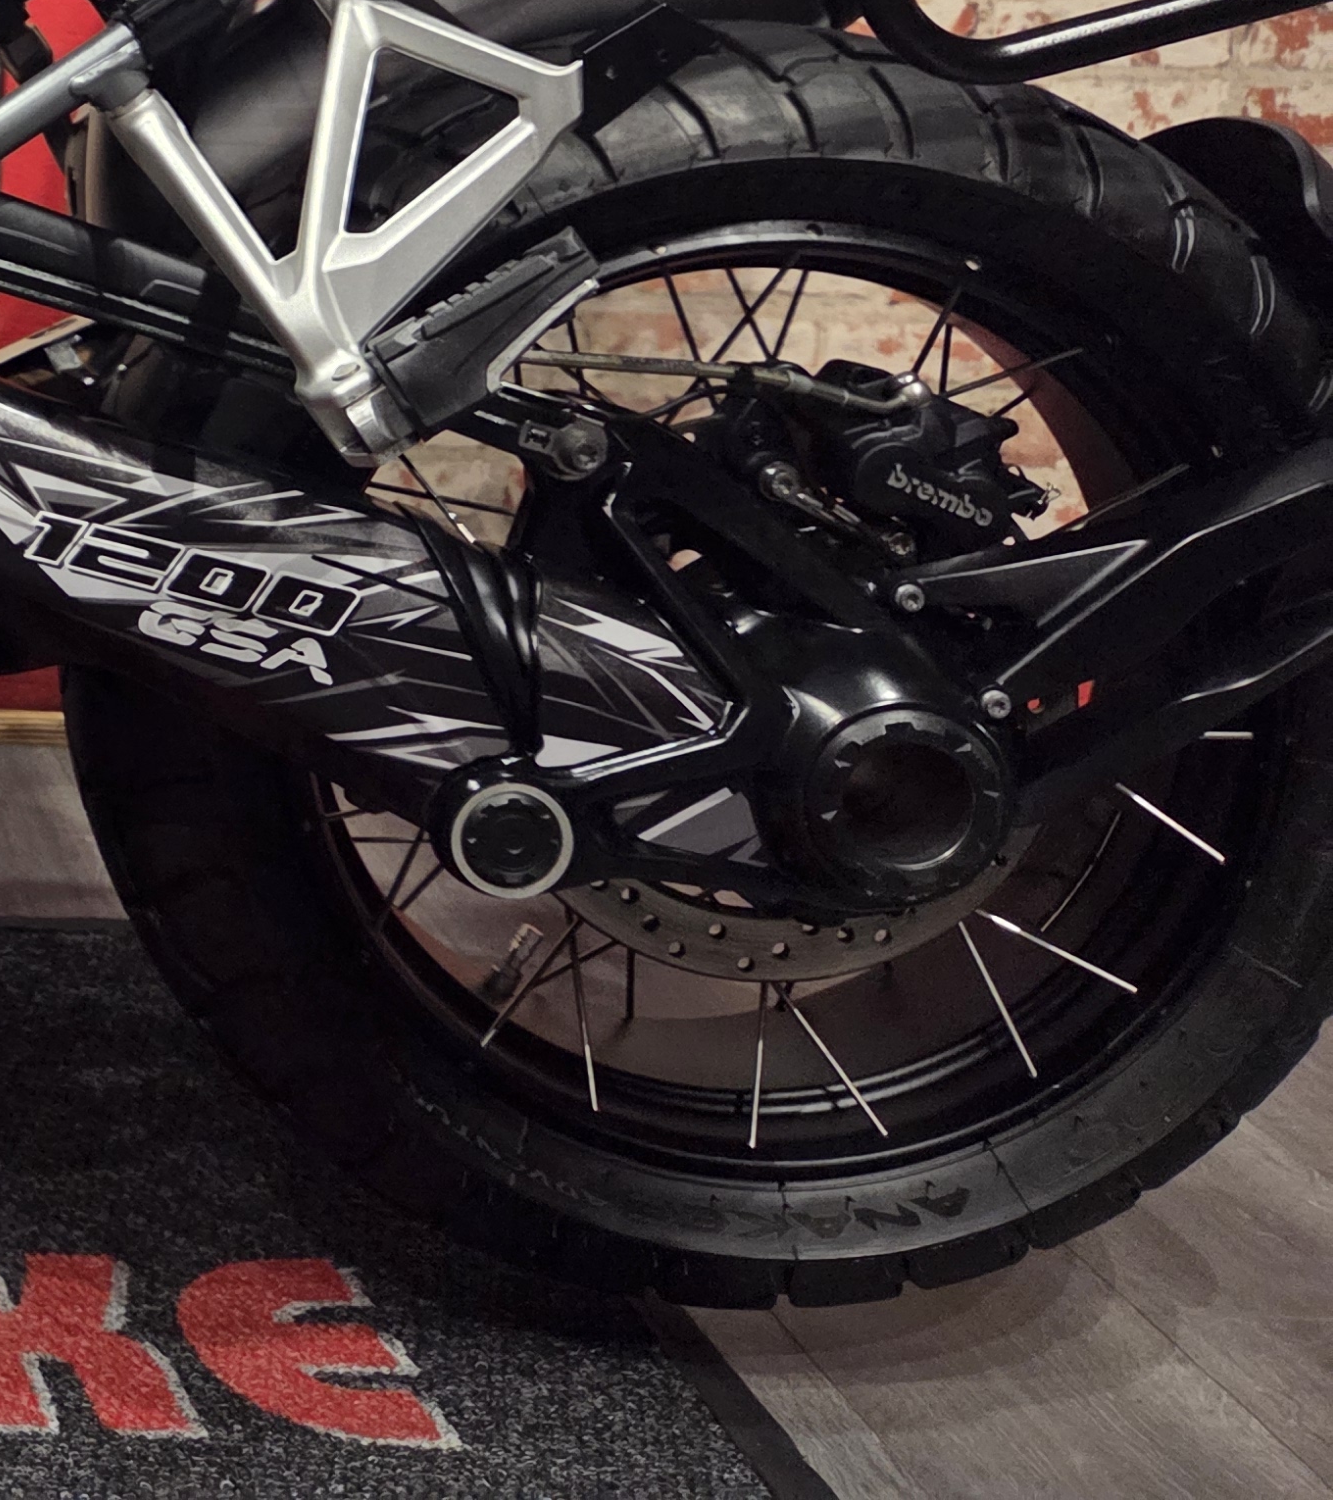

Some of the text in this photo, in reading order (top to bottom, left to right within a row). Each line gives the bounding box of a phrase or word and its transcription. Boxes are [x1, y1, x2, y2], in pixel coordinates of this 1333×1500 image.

[886, 463, 993, 528] brembo
[23, 510, 363, 637] 1200
[138, 601, 334, 686] GSA
